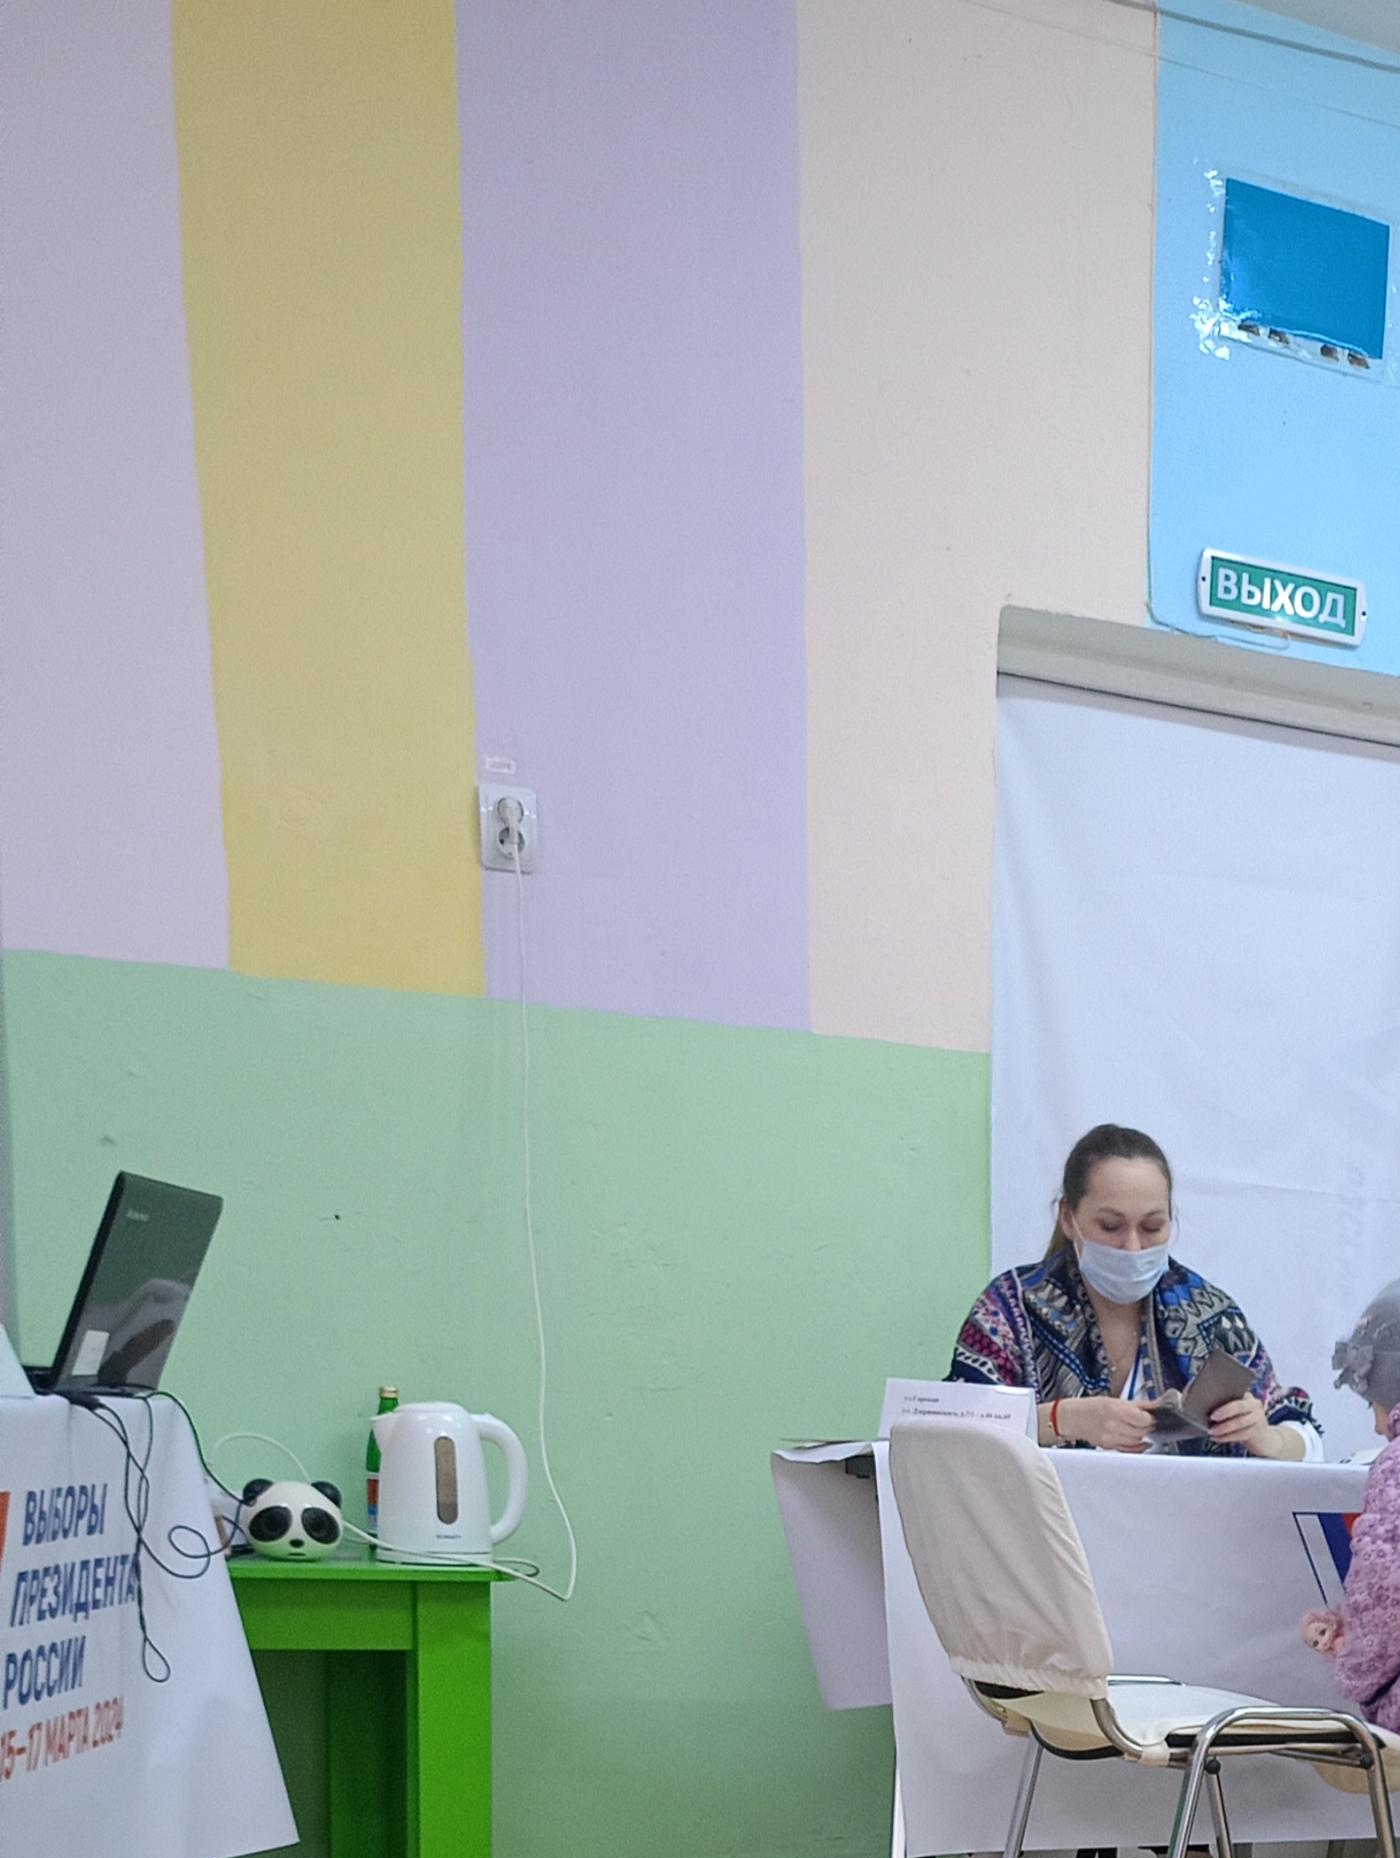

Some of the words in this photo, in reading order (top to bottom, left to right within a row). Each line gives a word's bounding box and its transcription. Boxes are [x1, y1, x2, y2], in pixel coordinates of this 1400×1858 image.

[1217, 567, 1347, 629] ВЫХОД
[22, 1483, 108, 1546] ВЫБОРЫ
[9, 1553, 138, 1628] ПРЕЗИДЕНТА
[1, 1634, 86, 1710] РОССИИ
[44, 1706, 89, 1768] МАРТА
[92, 1694, 124, 1748] 2024
